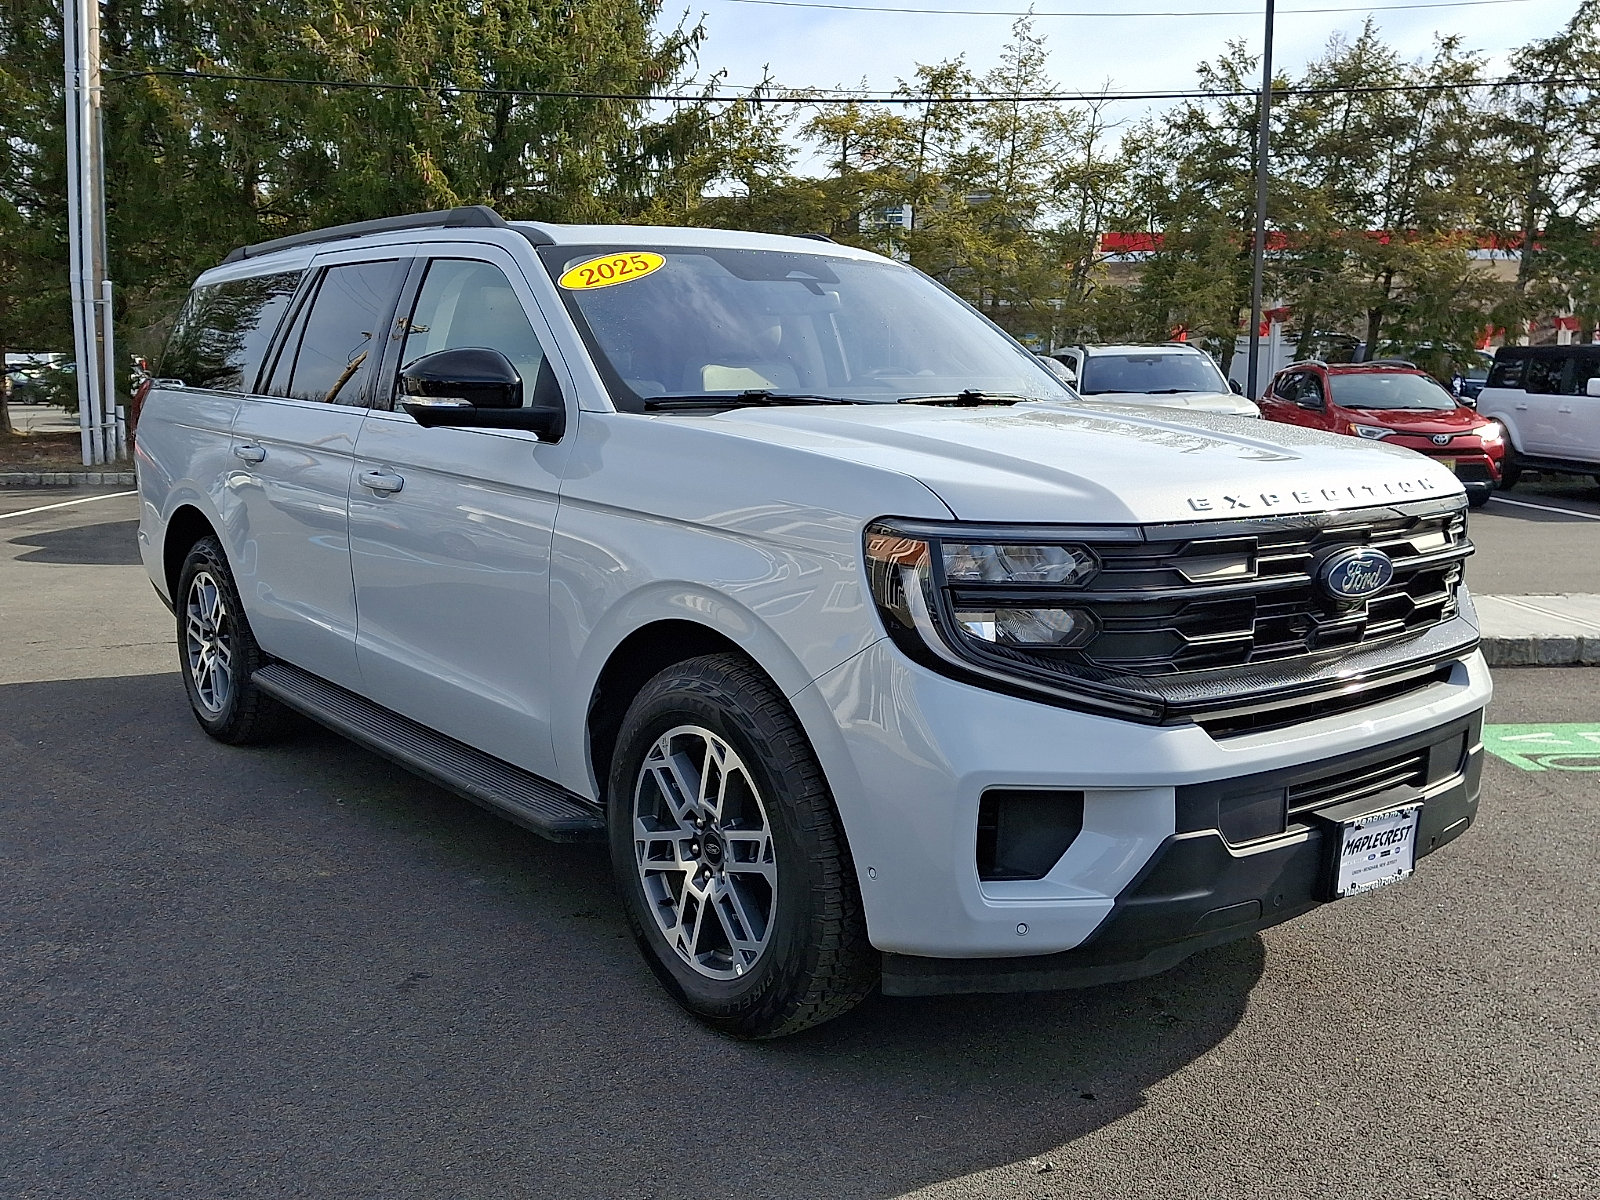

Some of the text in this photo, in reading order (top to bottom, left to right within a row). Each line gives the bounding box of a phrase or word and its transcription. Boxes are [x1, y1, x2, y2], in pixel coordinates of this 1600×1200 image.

[579, 254, 649, 285] 2025
[1187, 477, 1435, 511] EXPEDITION
[1341, 560, 1383, 591] Ford
[1343, 825, 1413, 856] MAPLECREST
